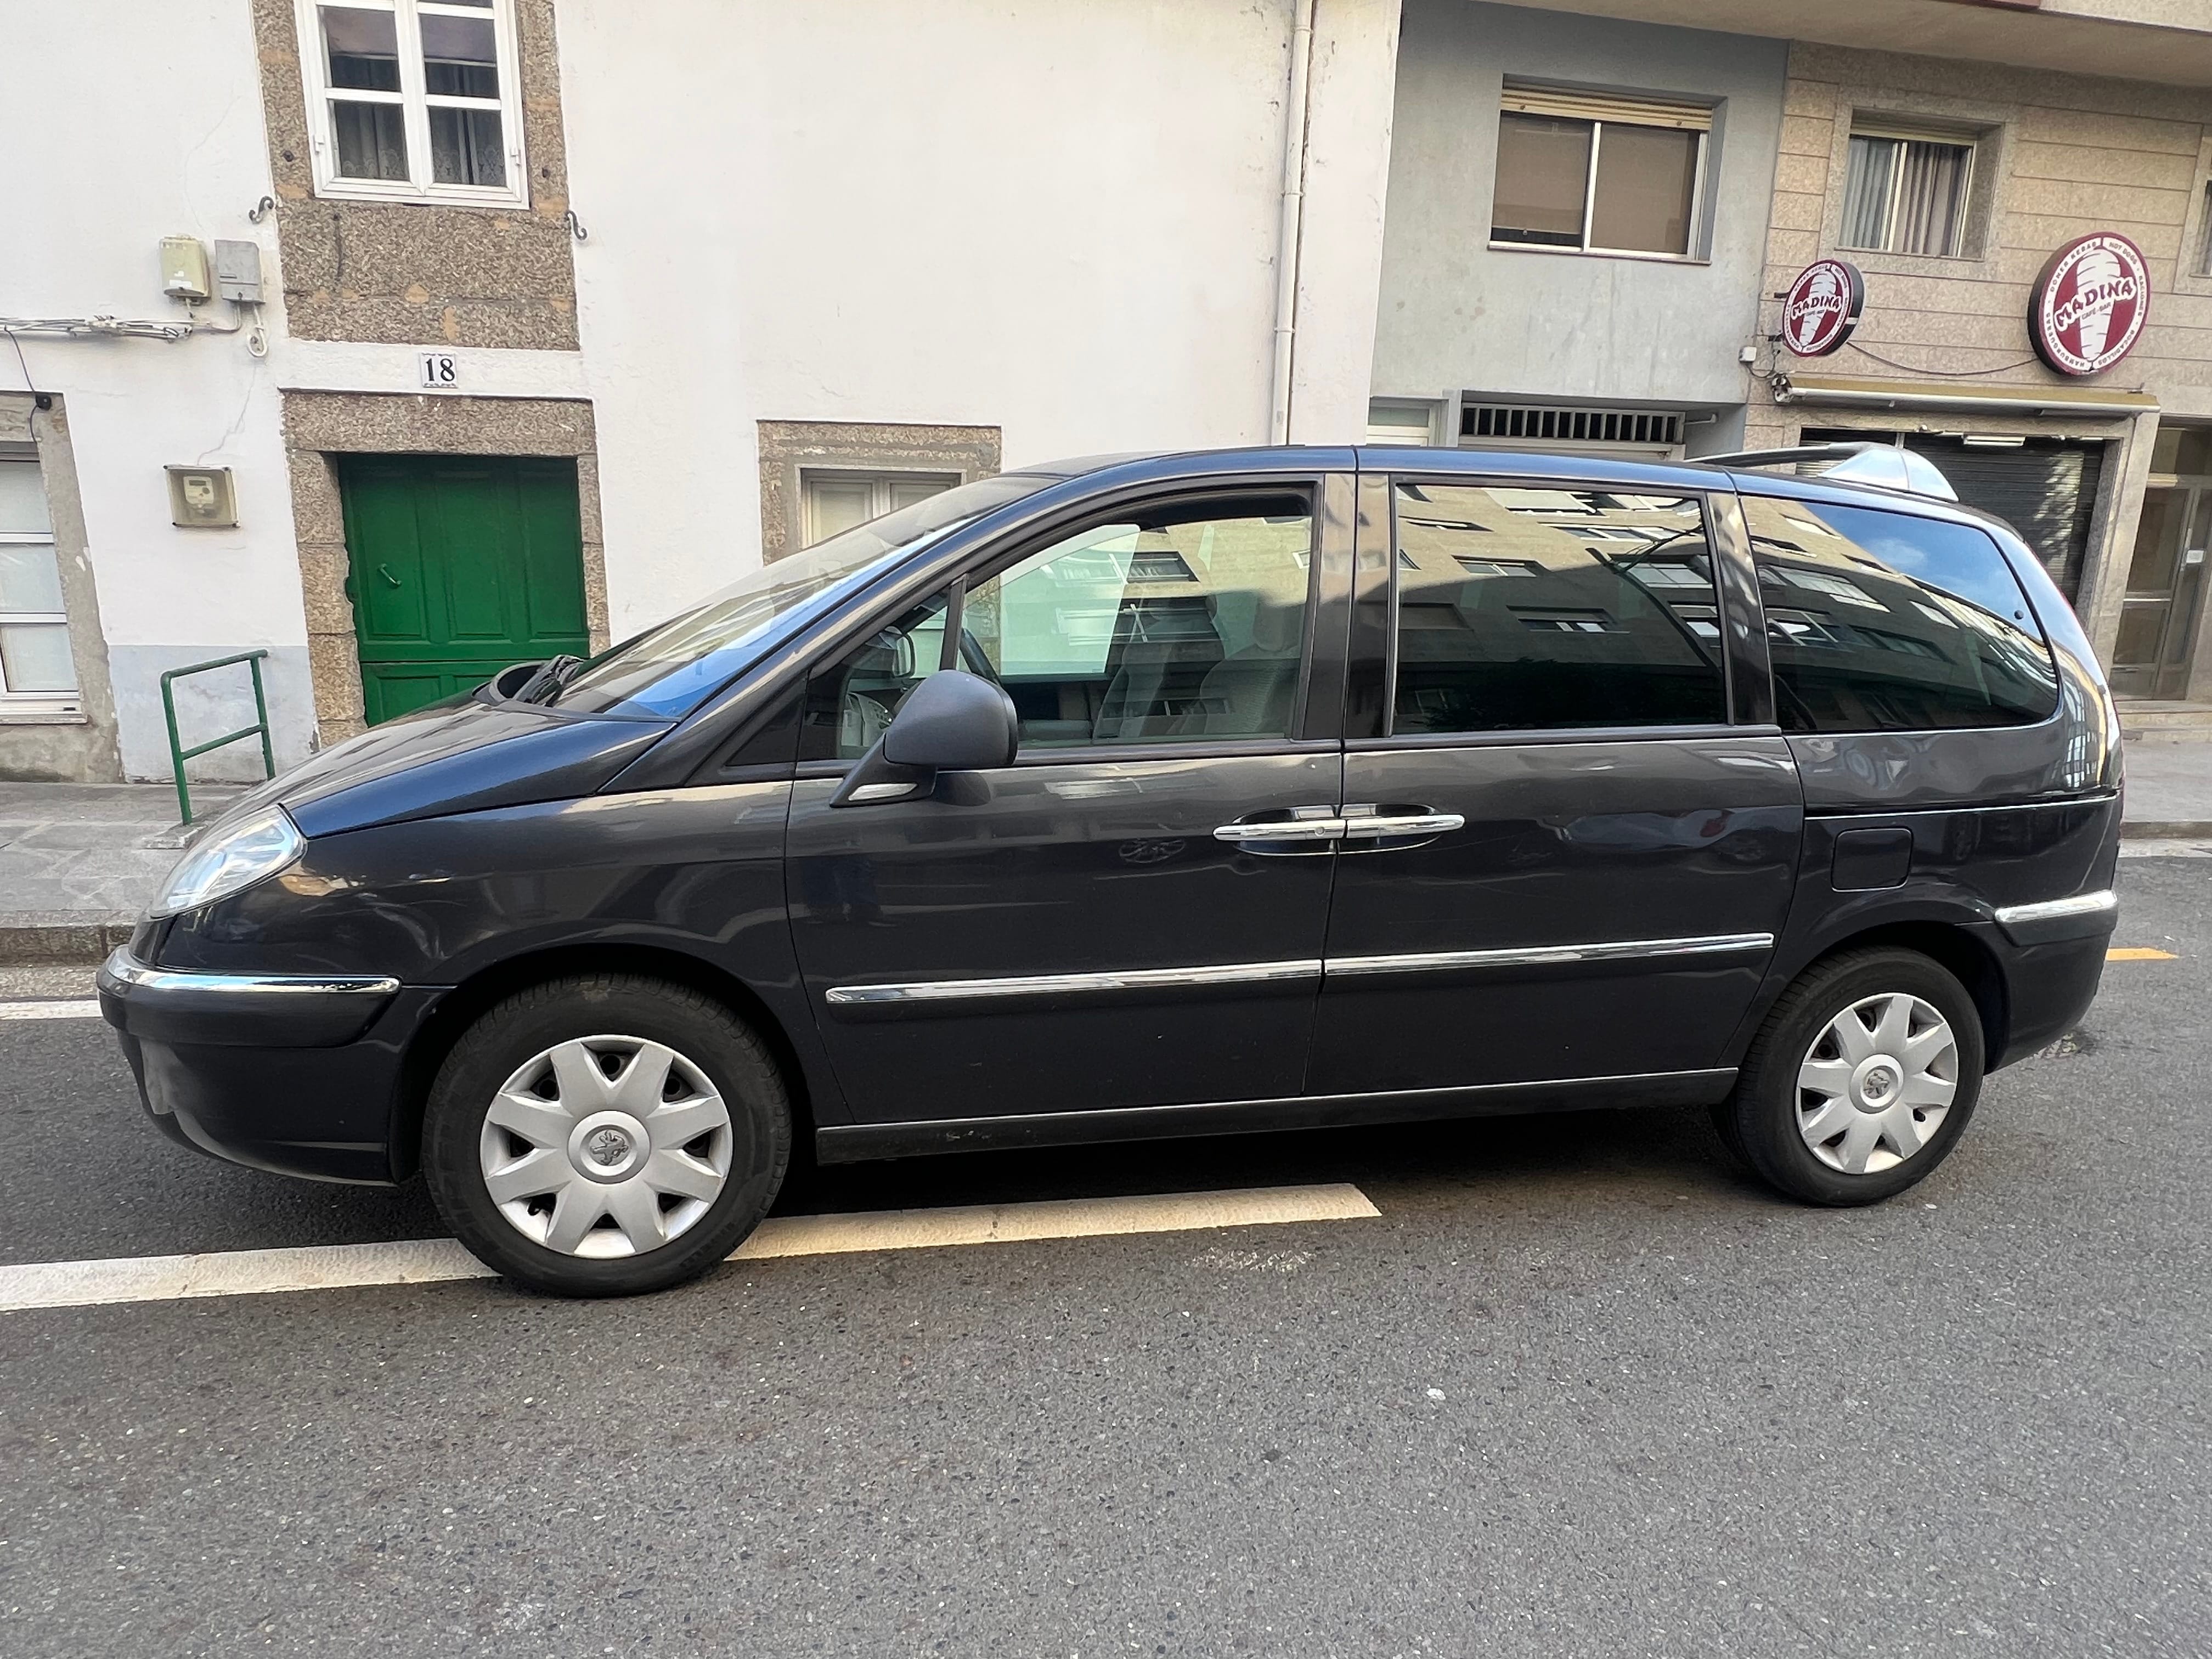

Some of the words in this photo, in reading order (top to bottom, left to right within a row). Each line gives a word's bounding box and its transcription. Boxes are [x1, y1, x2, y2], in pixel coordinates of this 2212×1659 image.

[1792, 295, 1840, 318] MADINA
[2056, 279, 2134, 328] MADINA
[426, 358, 455, 382] 18
